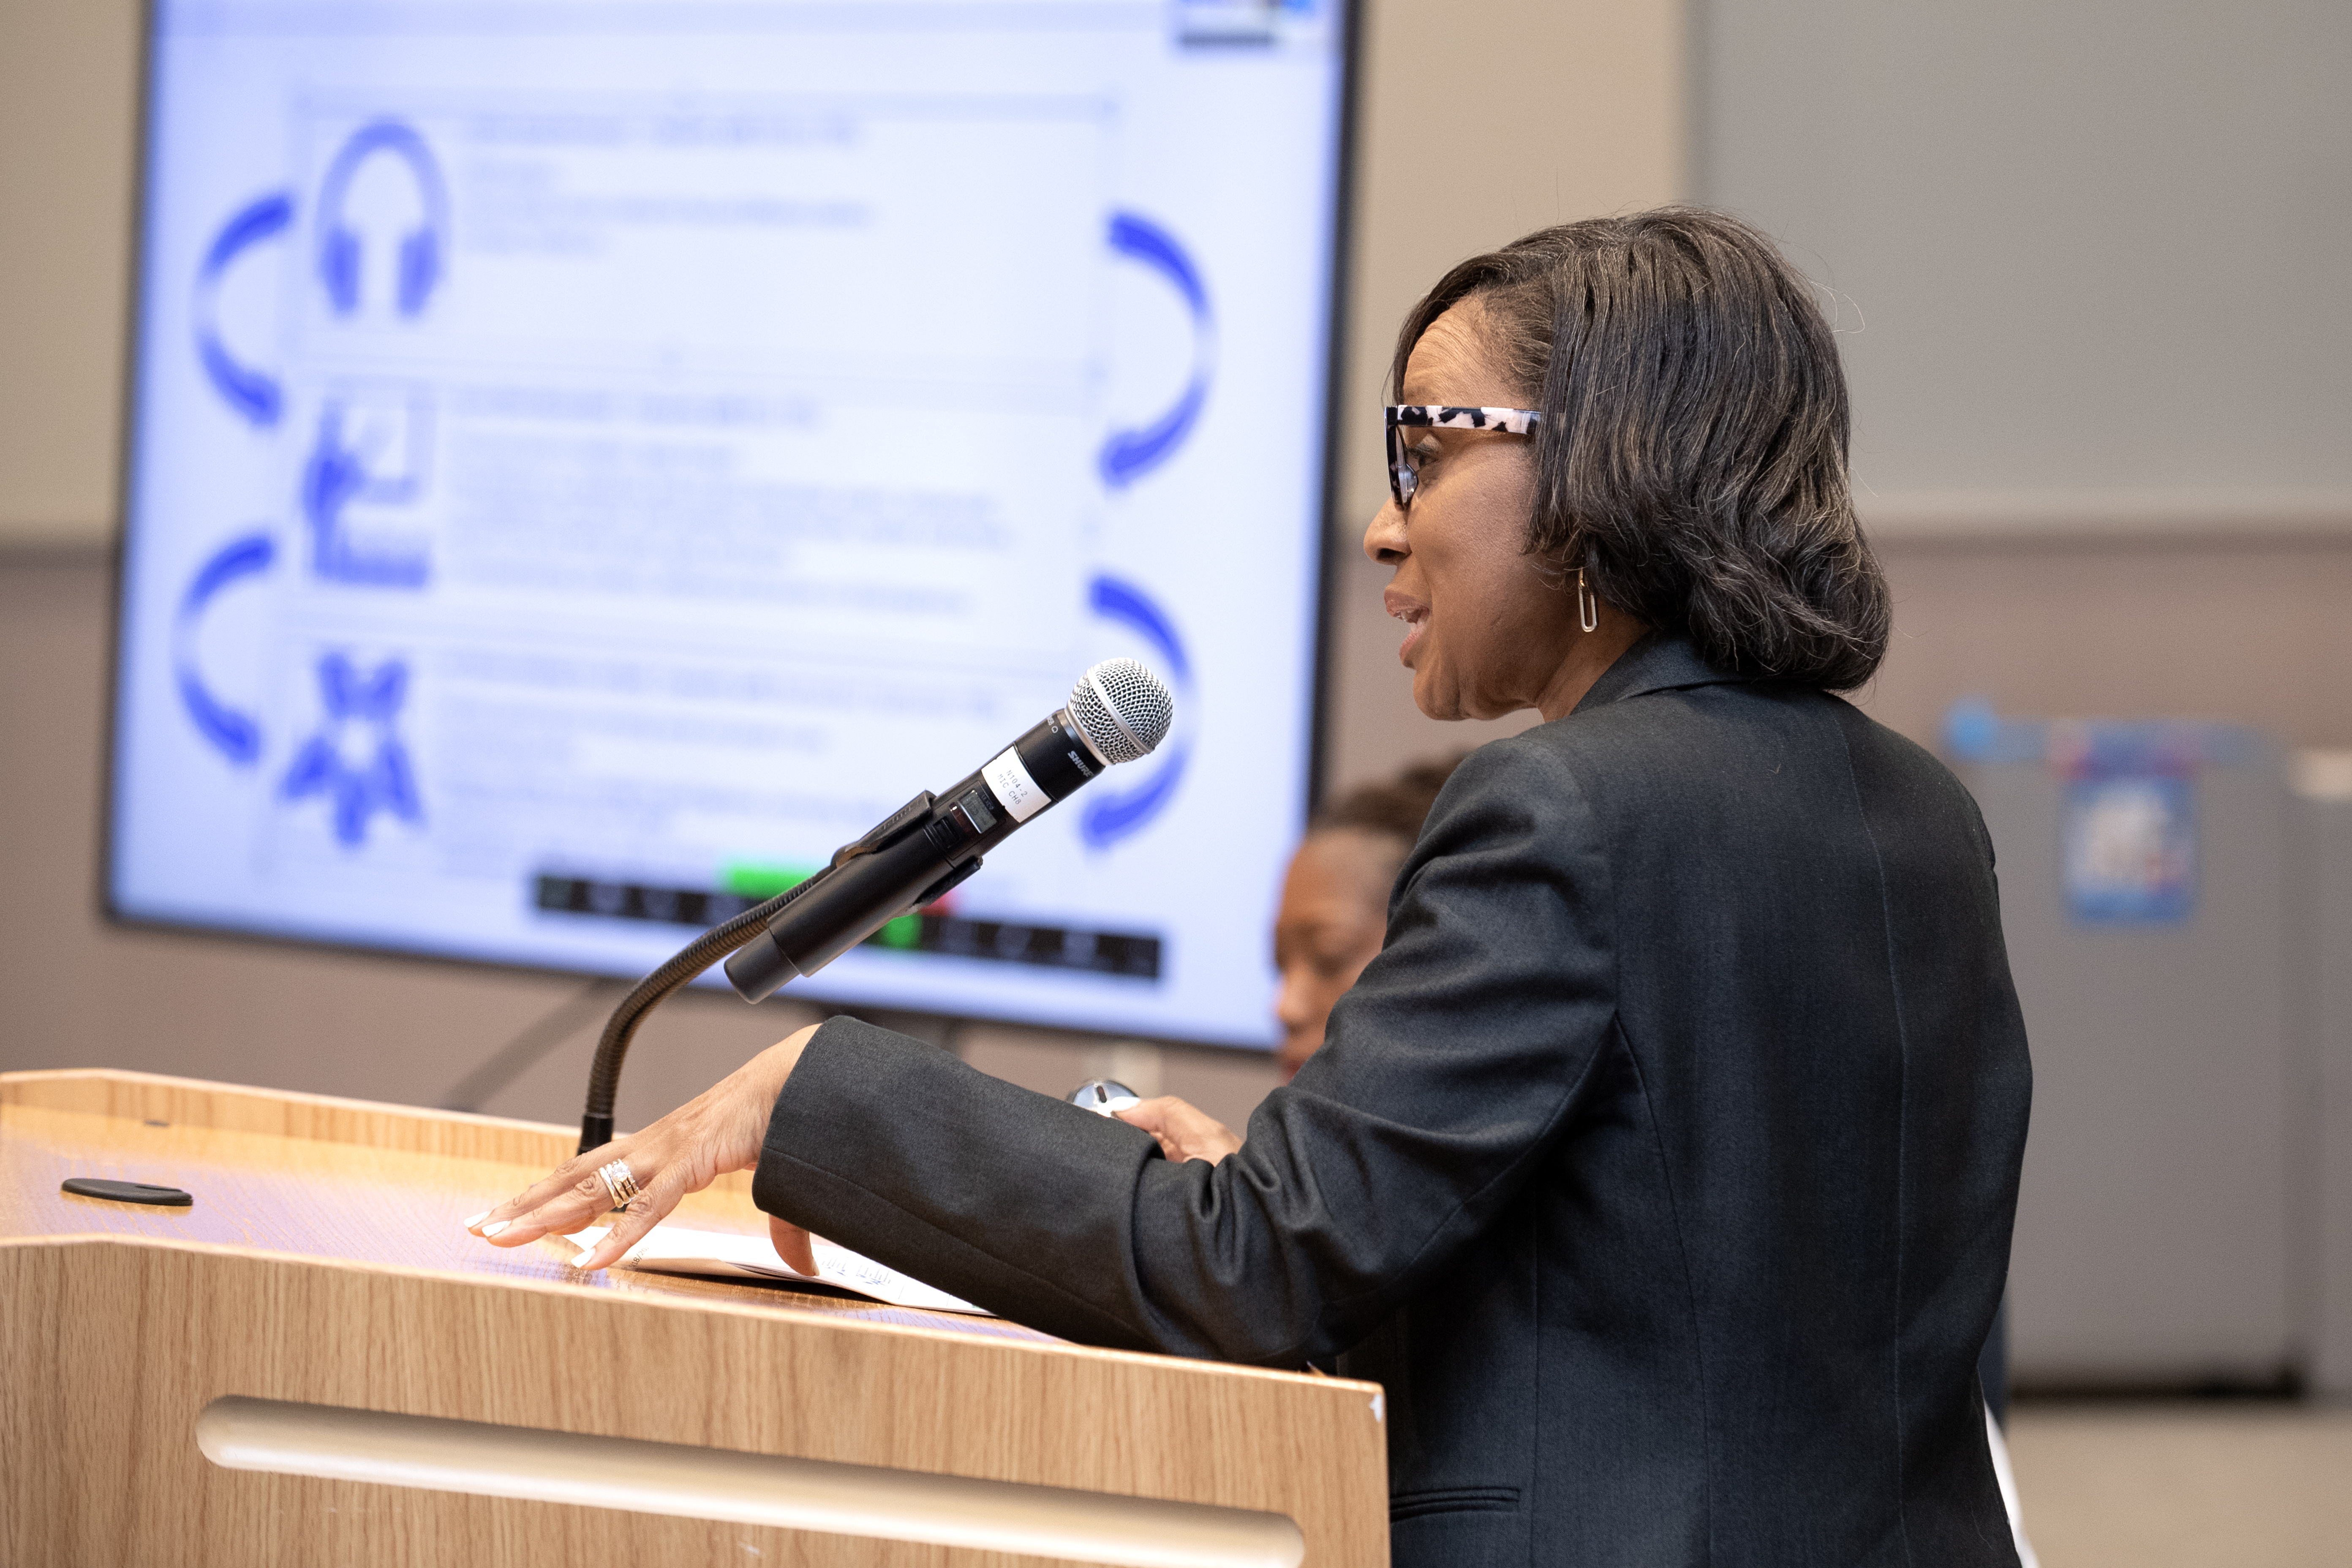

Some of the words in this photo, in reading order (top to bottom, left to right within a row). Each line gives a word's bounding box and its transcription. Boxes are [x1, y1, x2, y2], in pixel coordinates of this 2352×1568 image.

[1067, 750, 1093, 777] SHURE
[997, 774, 1009, 788] MIC
[1008, 791, 1021, 805] CH8
[1006, 770, 1027, 797] N104-2
